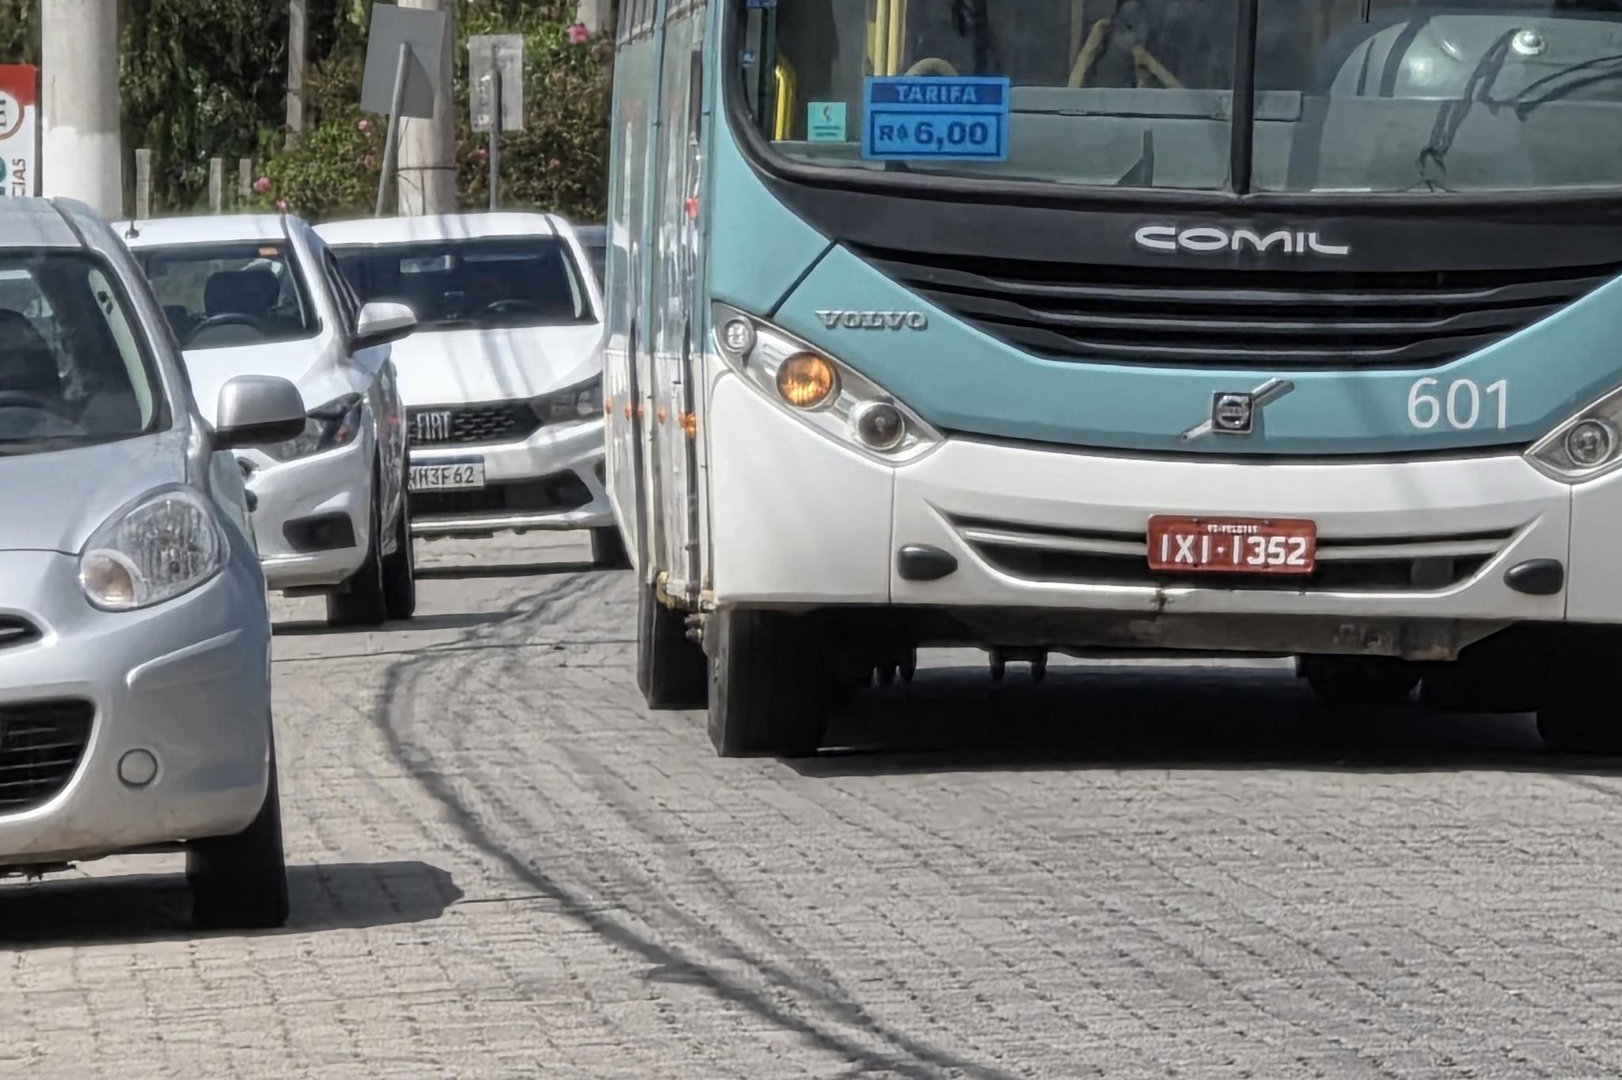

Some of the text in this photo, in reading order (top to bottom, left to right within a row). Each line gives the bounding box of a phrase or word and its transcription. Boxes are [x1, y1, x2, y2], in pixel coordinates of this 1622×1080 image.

[896, 84, 978, 103] TARIFA
[914, 121, 989, 151] 6,00
[1135, 225, 1350, 255] COMIL
[815, 309, 927, 331] VOLVO
[1407, 377, 1507, 430] 601
[416, 410, 452, 440] FIAT
